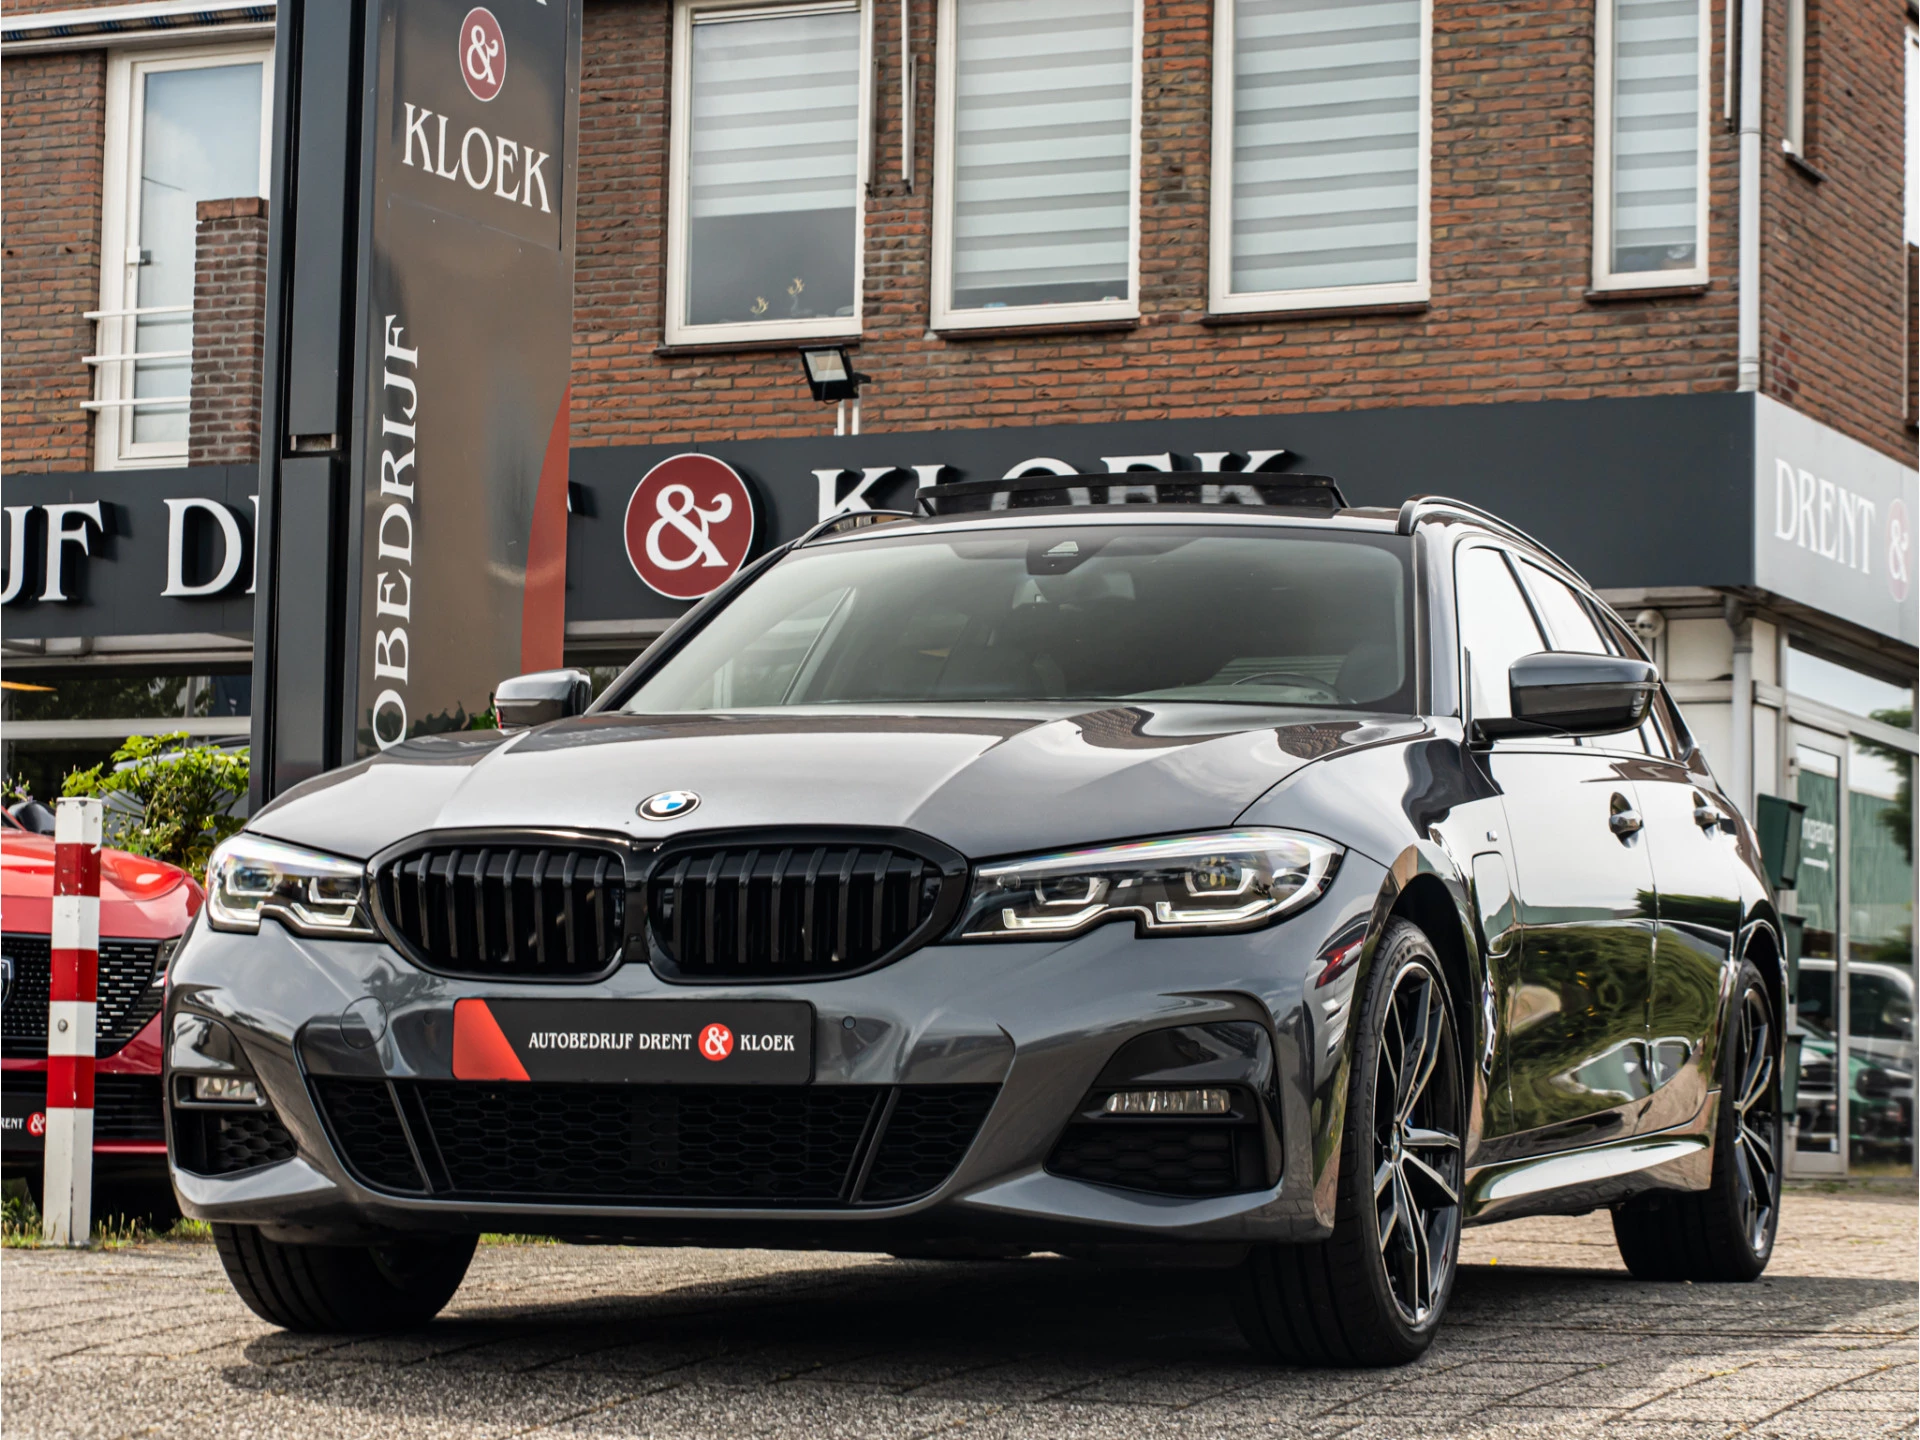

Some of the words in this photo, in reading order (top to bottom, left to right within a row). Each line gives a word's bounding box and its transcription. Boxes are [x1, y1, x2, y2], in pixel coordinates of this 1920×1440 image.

[466, 24, 499, 86] &
[402, 102, 551, 213] KLOEK
[160, 495, 259, 597] D
[645, 483, 733, 571] &
[1774, 457, 1876, 575] DRENT
[1888, 519, 1908, 583] &
[529, 1032, 634, 1050] AUTOBEDRIJF
[639, 1033, 692, 1050] DRENT
[705, 1026, 729, 1056] &
[740, 1034, 795, 1052] KLOEK
